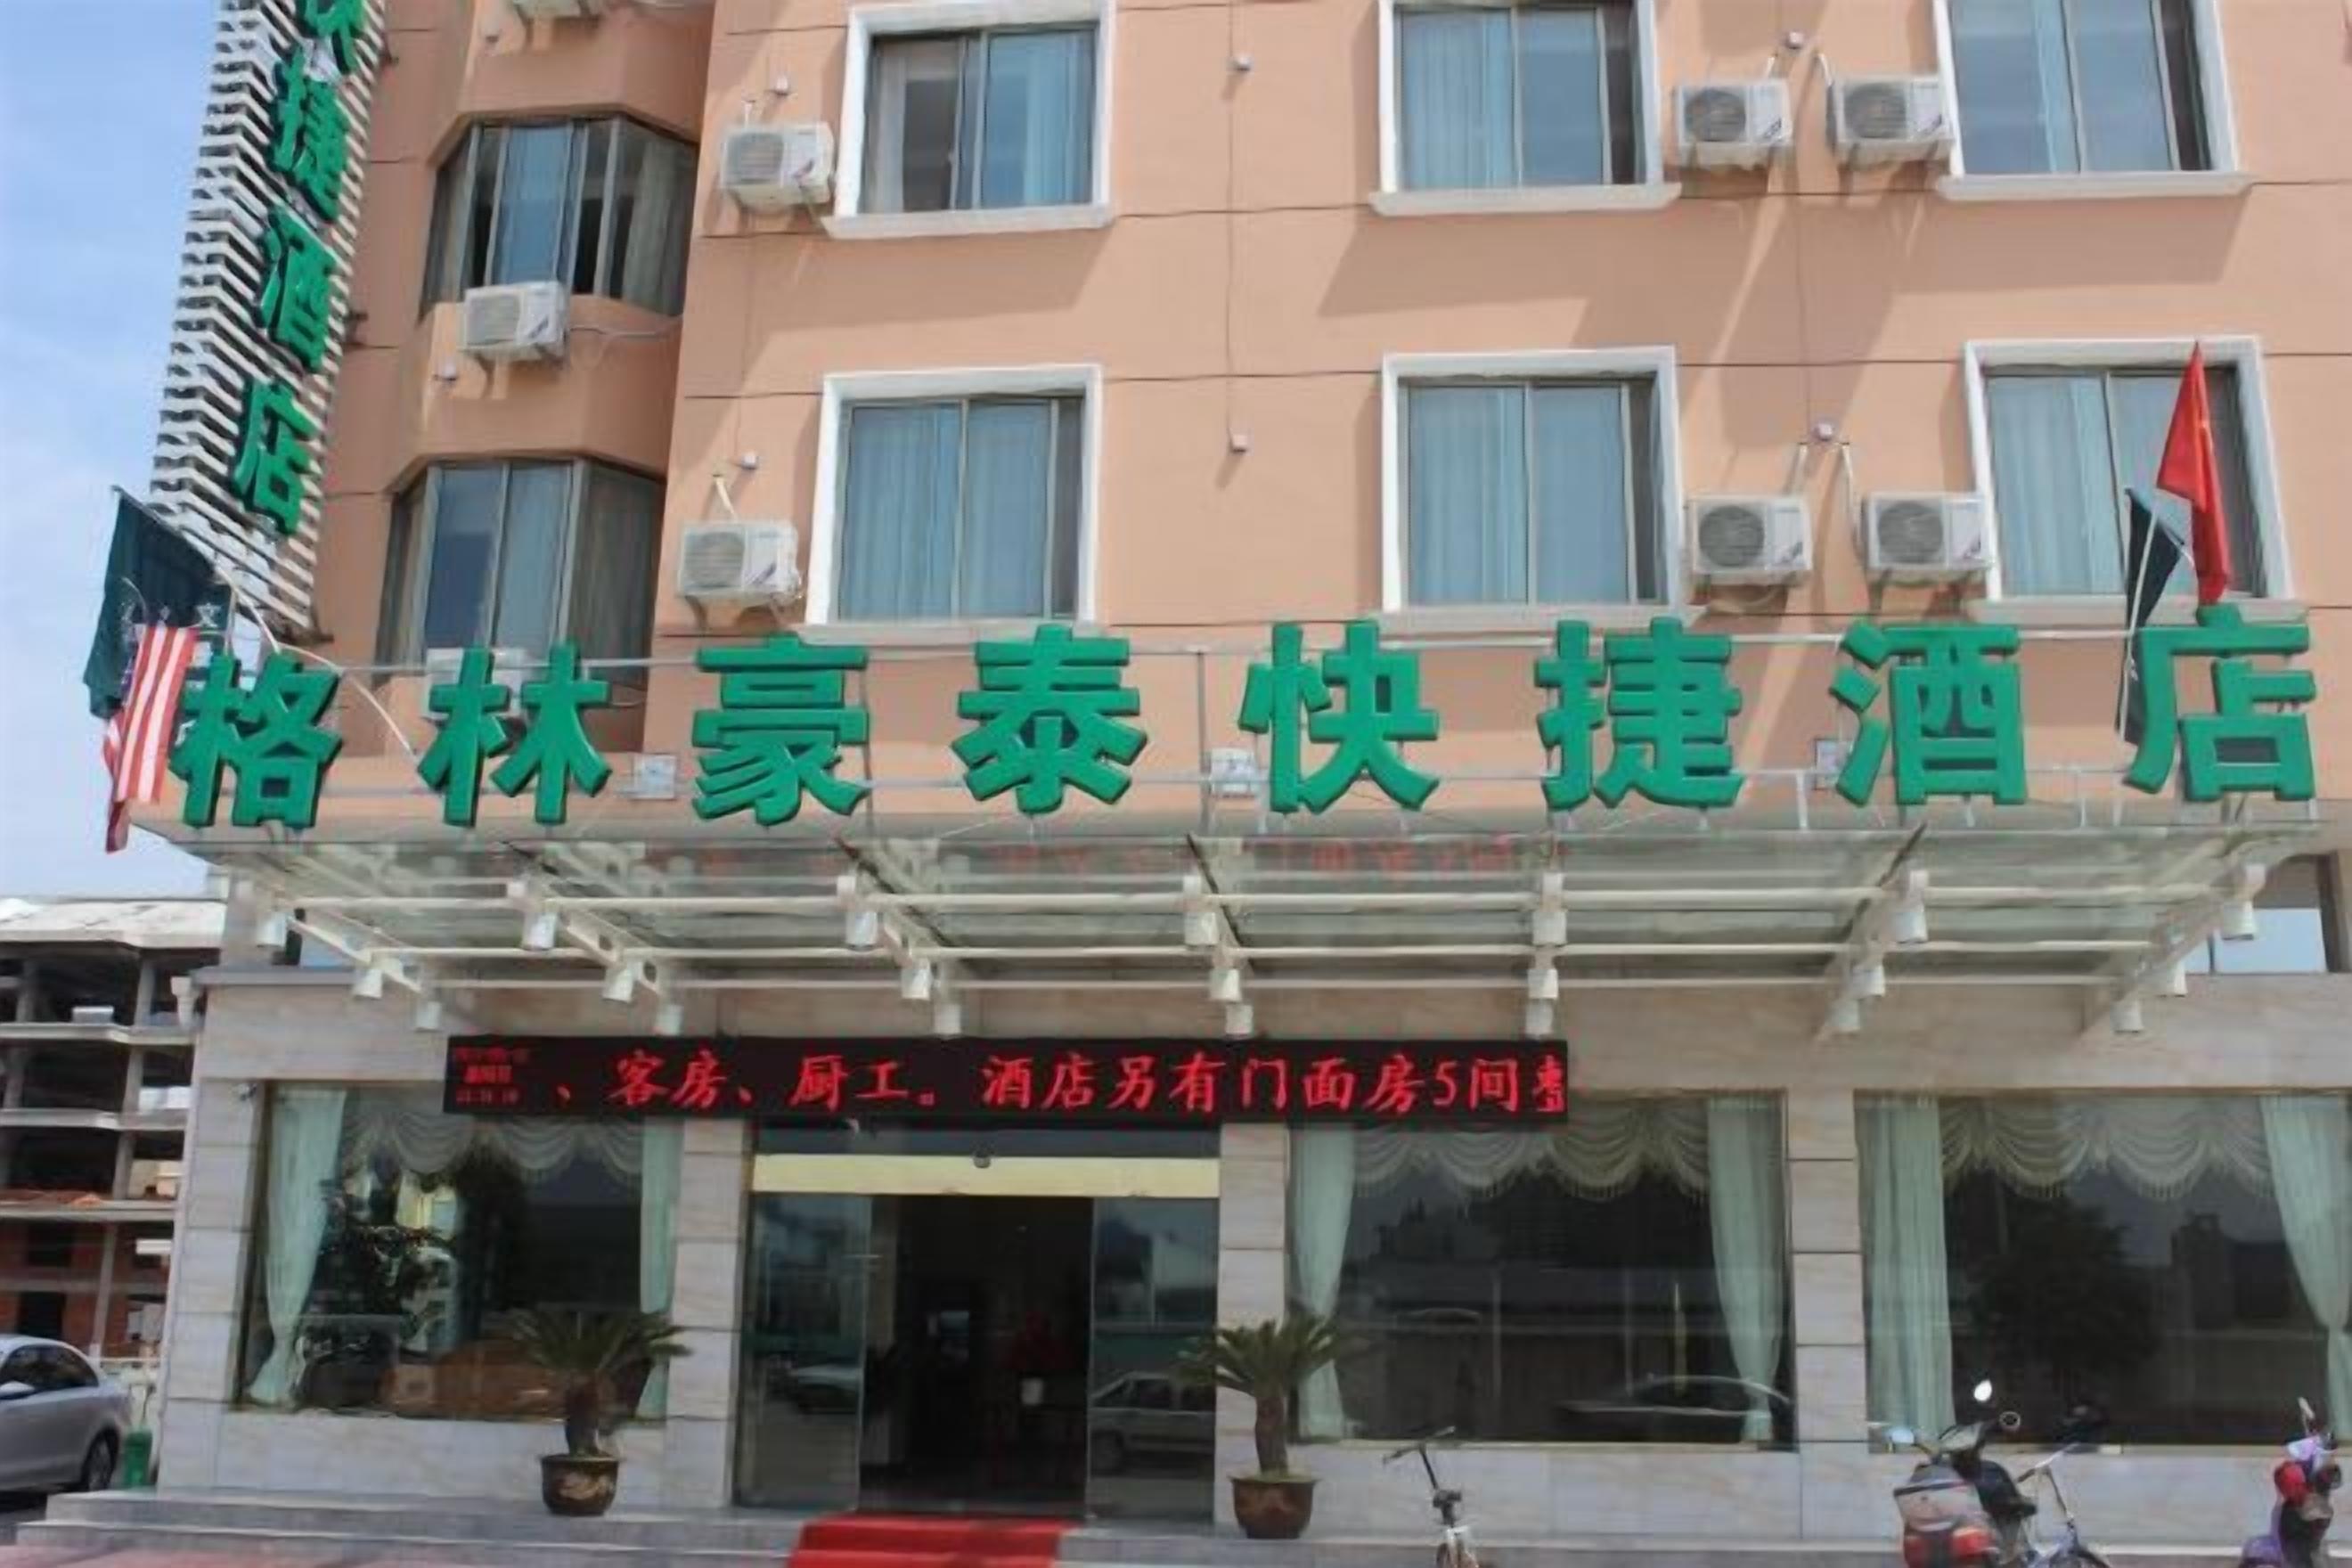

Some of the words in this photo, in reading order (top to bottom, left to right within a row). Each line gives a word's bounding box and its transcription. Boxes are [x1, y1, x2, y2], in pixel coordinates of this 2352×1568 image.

[167, 605, 2316, 827] 格林豪泰快捷酒店
